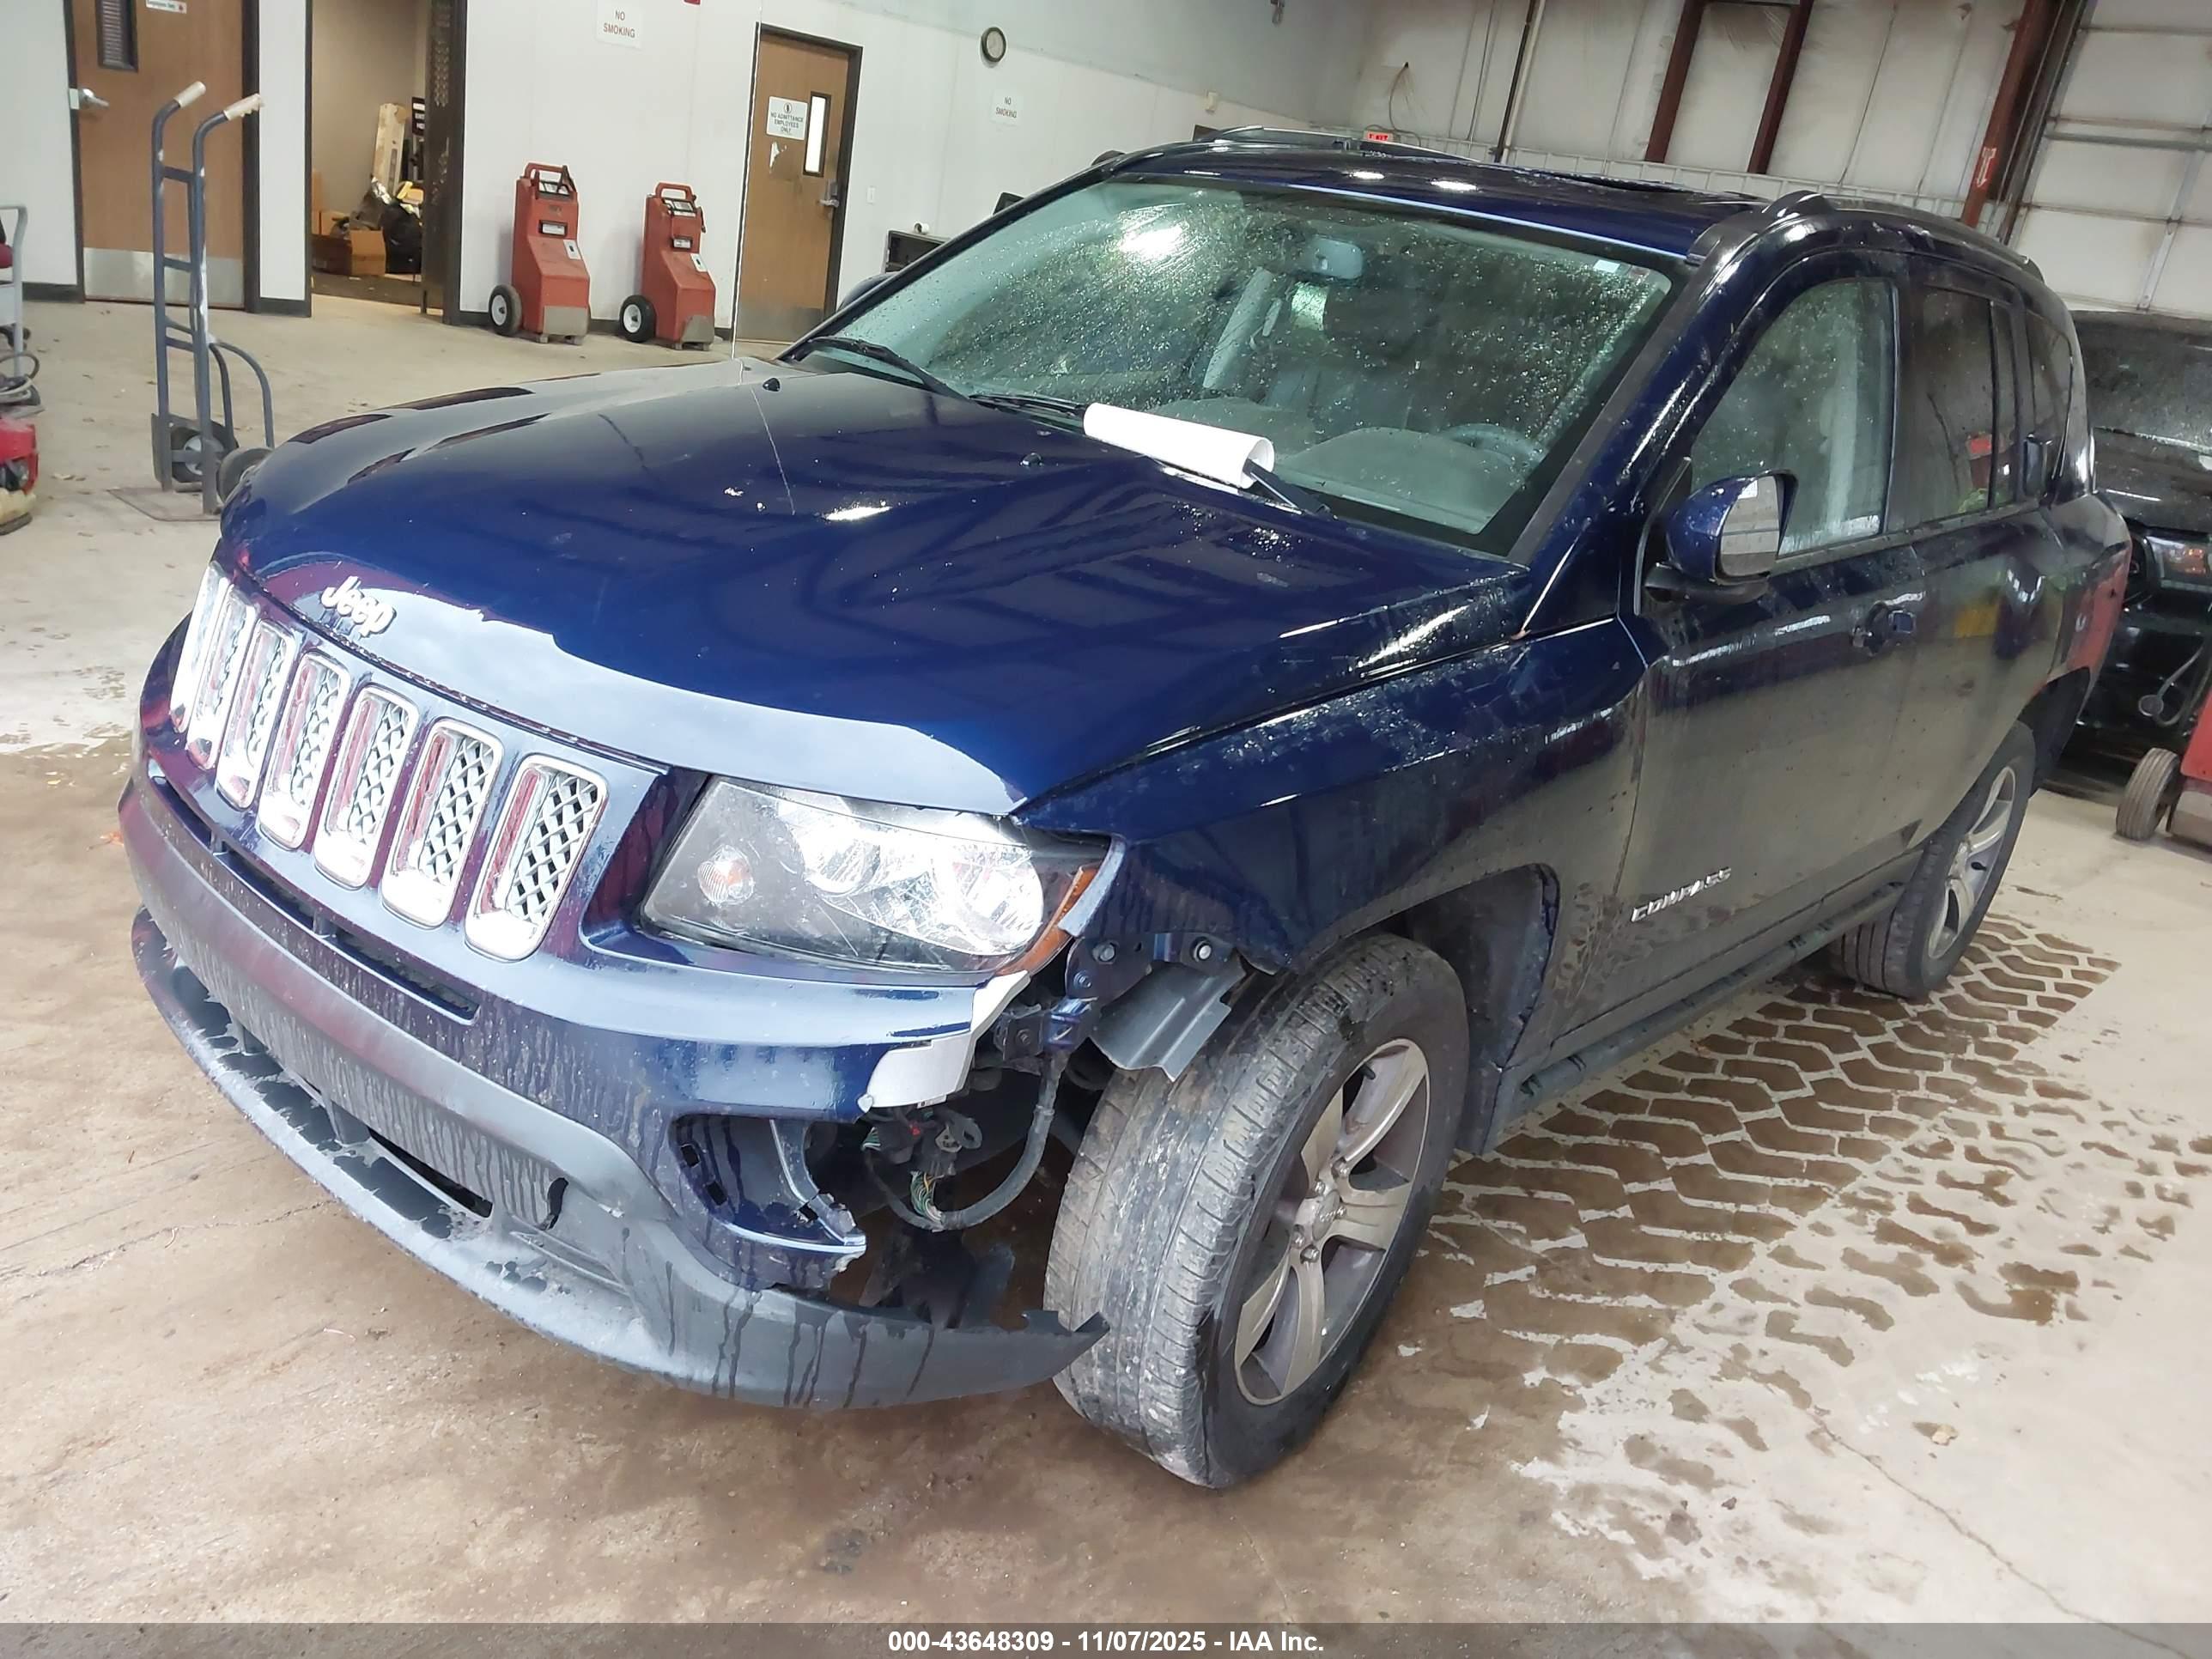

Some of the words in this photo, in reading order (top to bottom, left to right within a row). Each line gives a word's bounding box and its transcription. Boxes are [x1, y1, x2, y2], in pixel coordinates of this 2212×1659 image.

[615, 9, 626, 21] NO
[603, 22, 635, 39] SMOKING
[1004, 96, 1012, 106] NO
[777, 112, 804, 123] ADMITTANCE
[995, 106, 1017, 118] SMOKING
[774, 118, 799, 129] EMPLOYEES
[319, 575, 397, 638] Jeep
[1631, 867, 1732, 922] COMPASS
